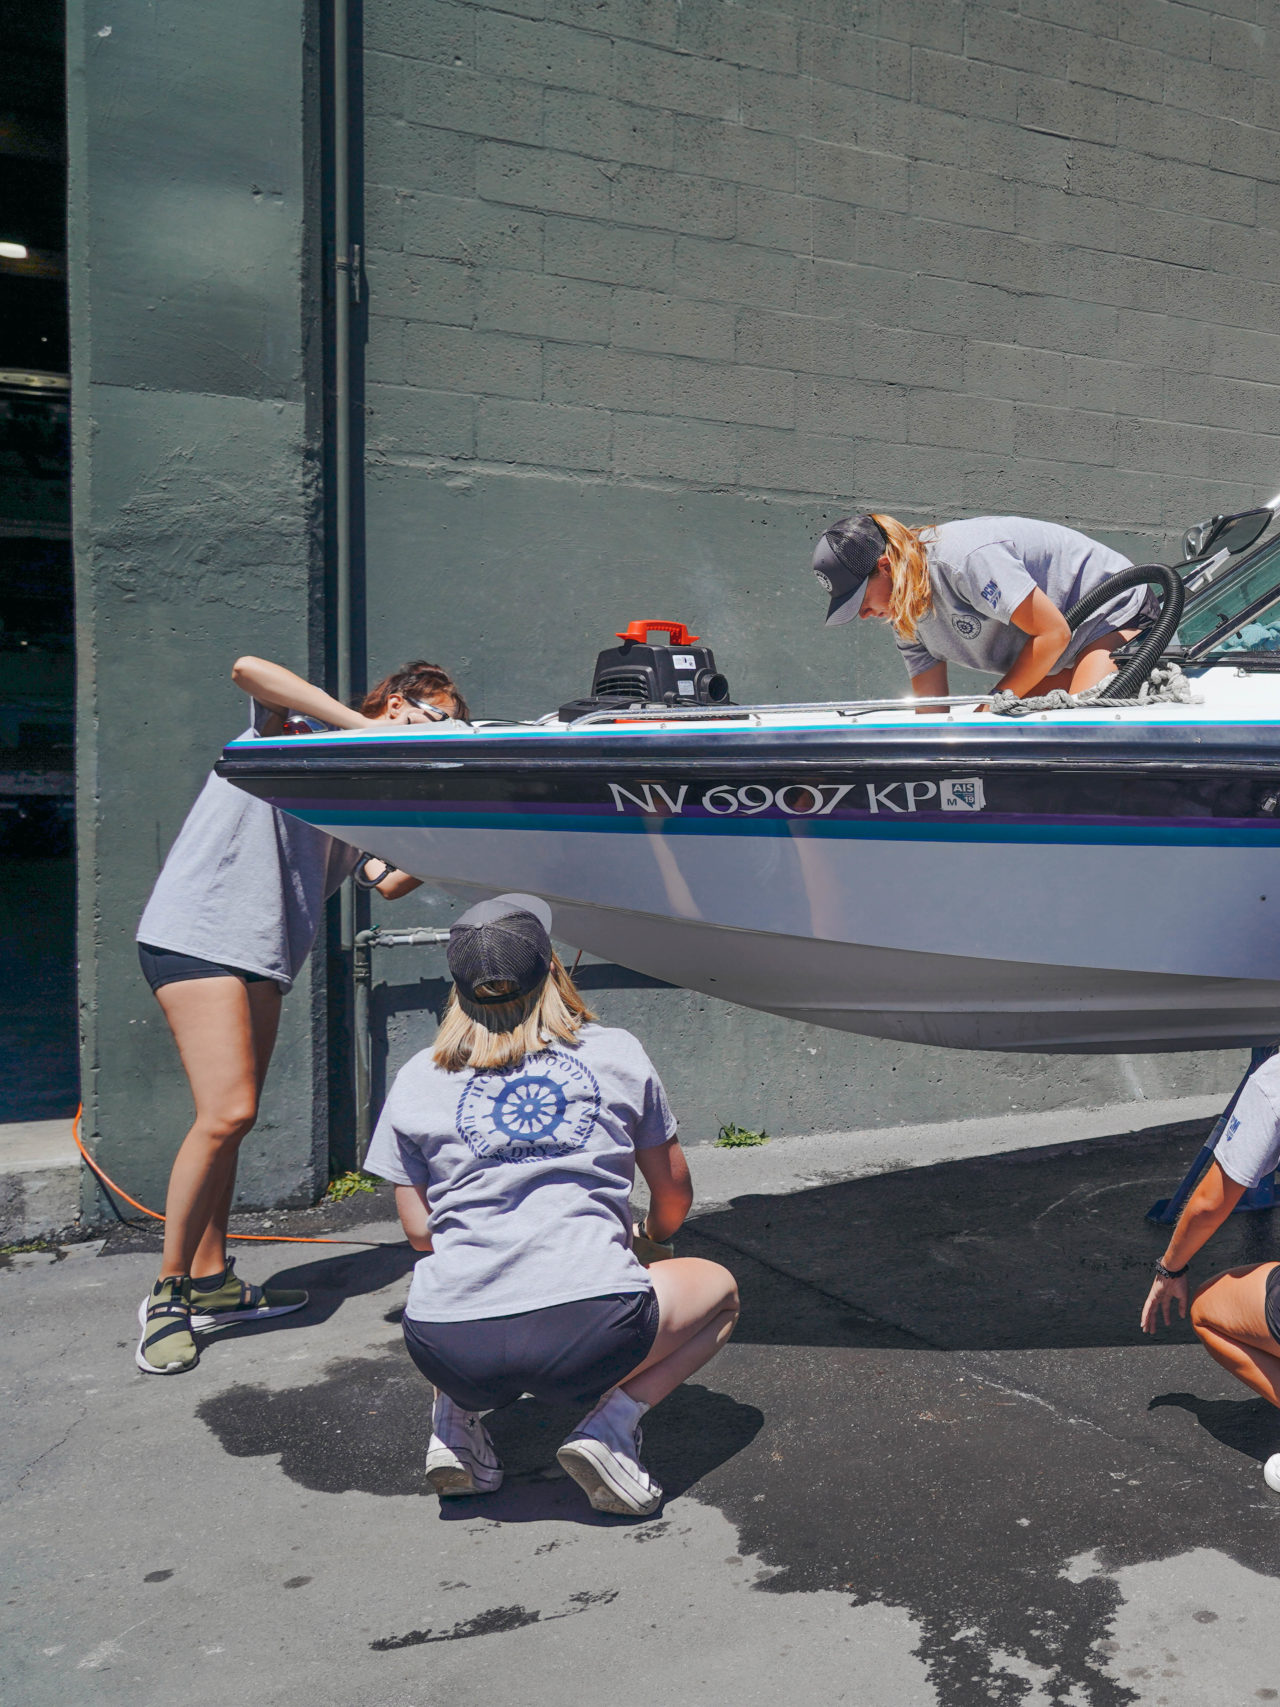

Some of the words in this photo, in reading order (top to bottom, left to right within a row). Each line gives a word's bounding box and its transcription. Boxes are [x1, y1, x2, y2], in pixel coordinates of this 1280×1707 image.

[607, 783, 689, 814] NV
[701, 783, 856, 815] 6907
[866, 780, 938, 813] KP
[946, 798, 958, 806] M
[953, 783, 974, 793] AIS
[470, 1054, 583, 1099] HOWOOD
[463, 1114, 491, 1153] HIGH
[511, 1144, 549, 1158] DRY
